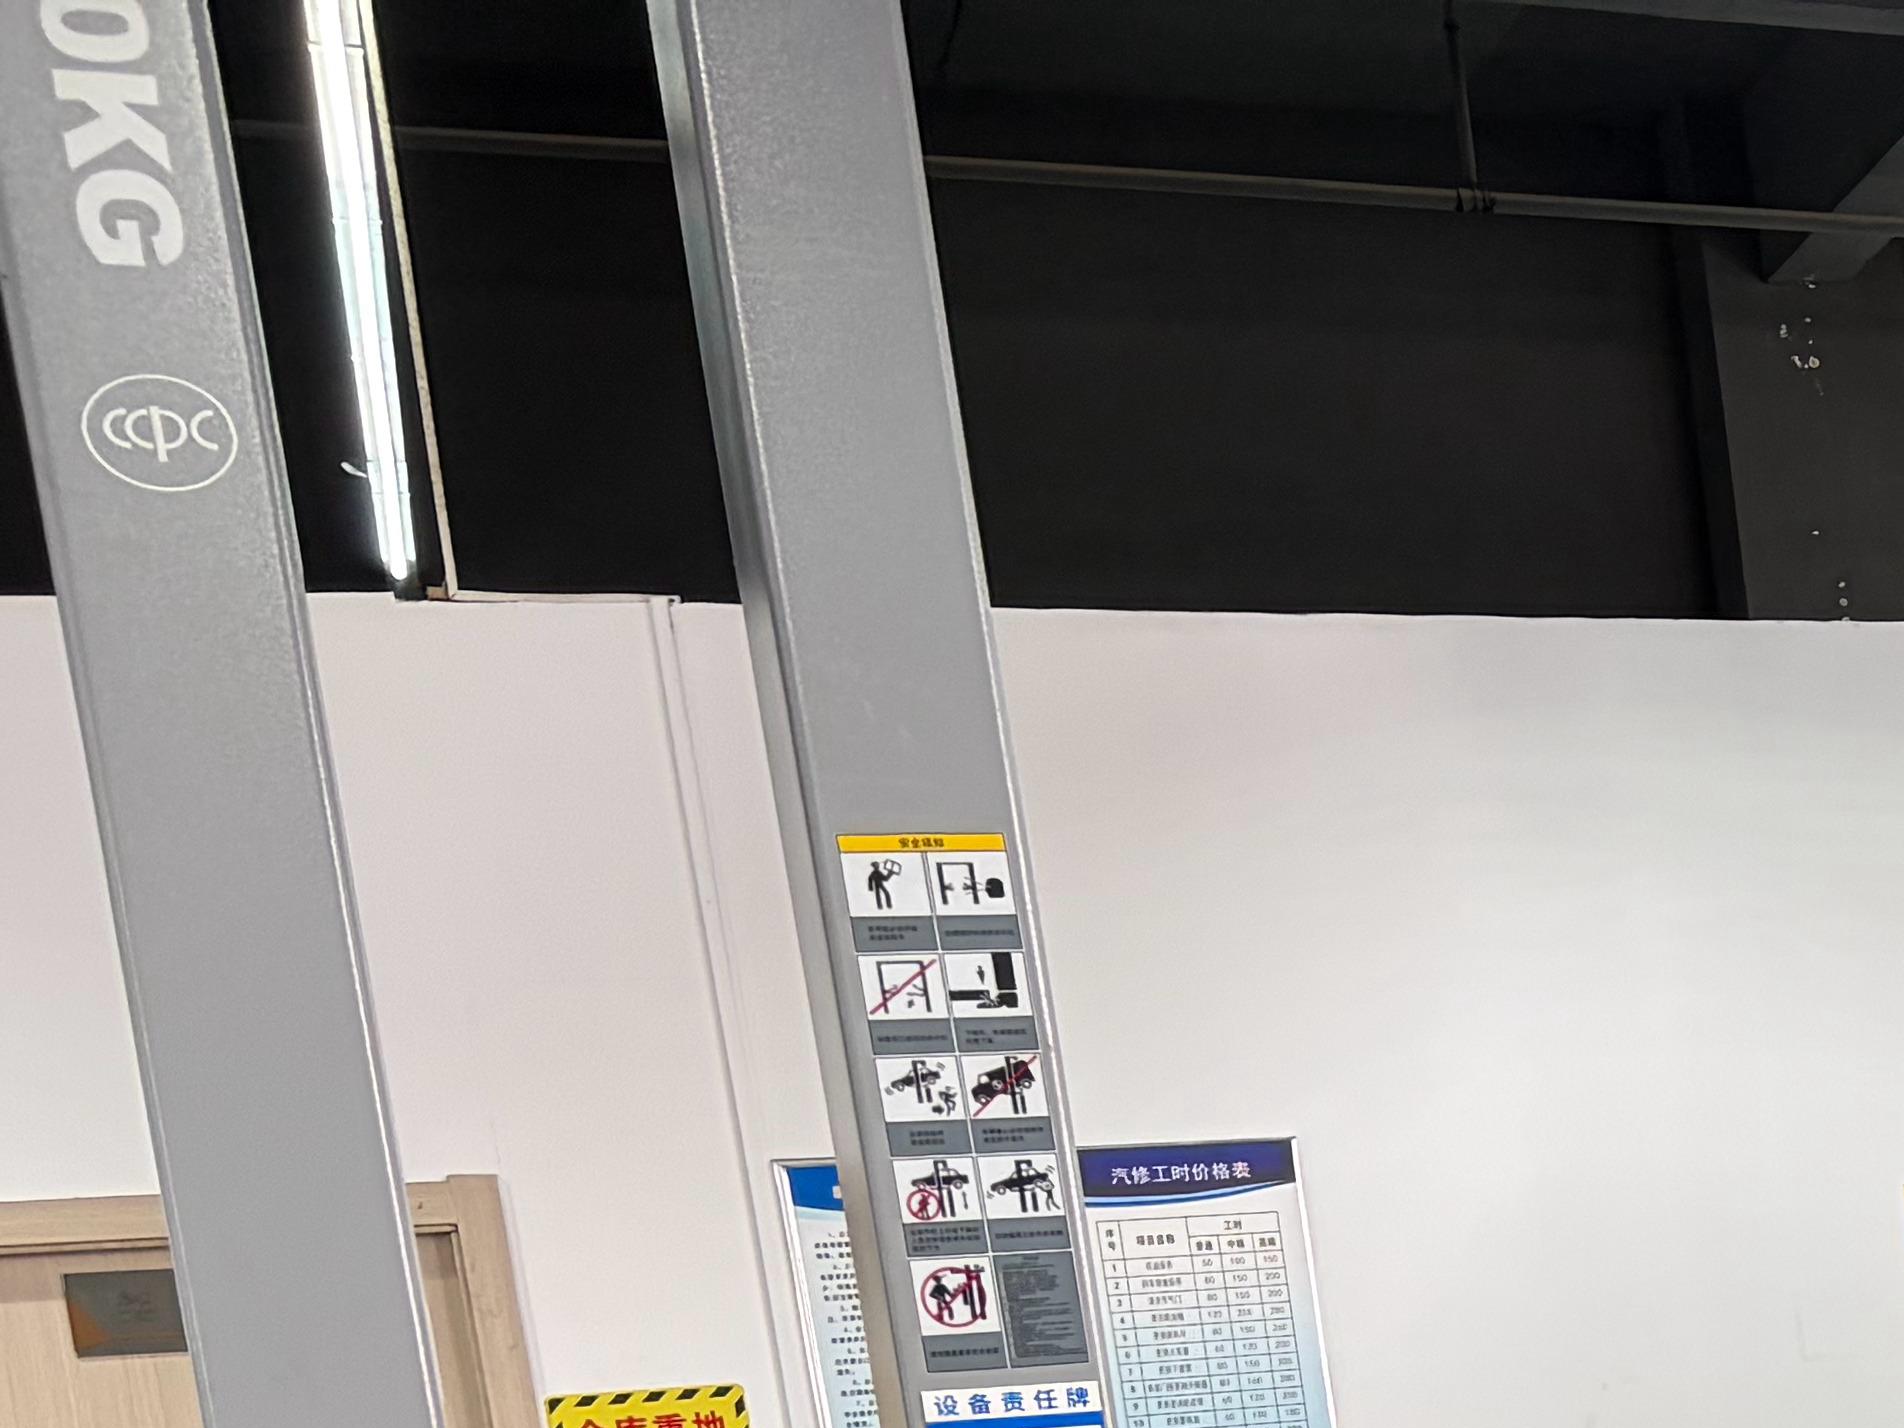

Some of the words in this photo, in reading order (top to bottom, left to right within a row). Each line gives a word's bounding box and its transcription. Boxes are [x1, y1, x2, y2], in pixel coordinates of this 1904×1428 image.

[1111, 1161, 1251, 1185] 汽修工时价格表
[934, 1387, 1090, 1416] 设备责任牌
